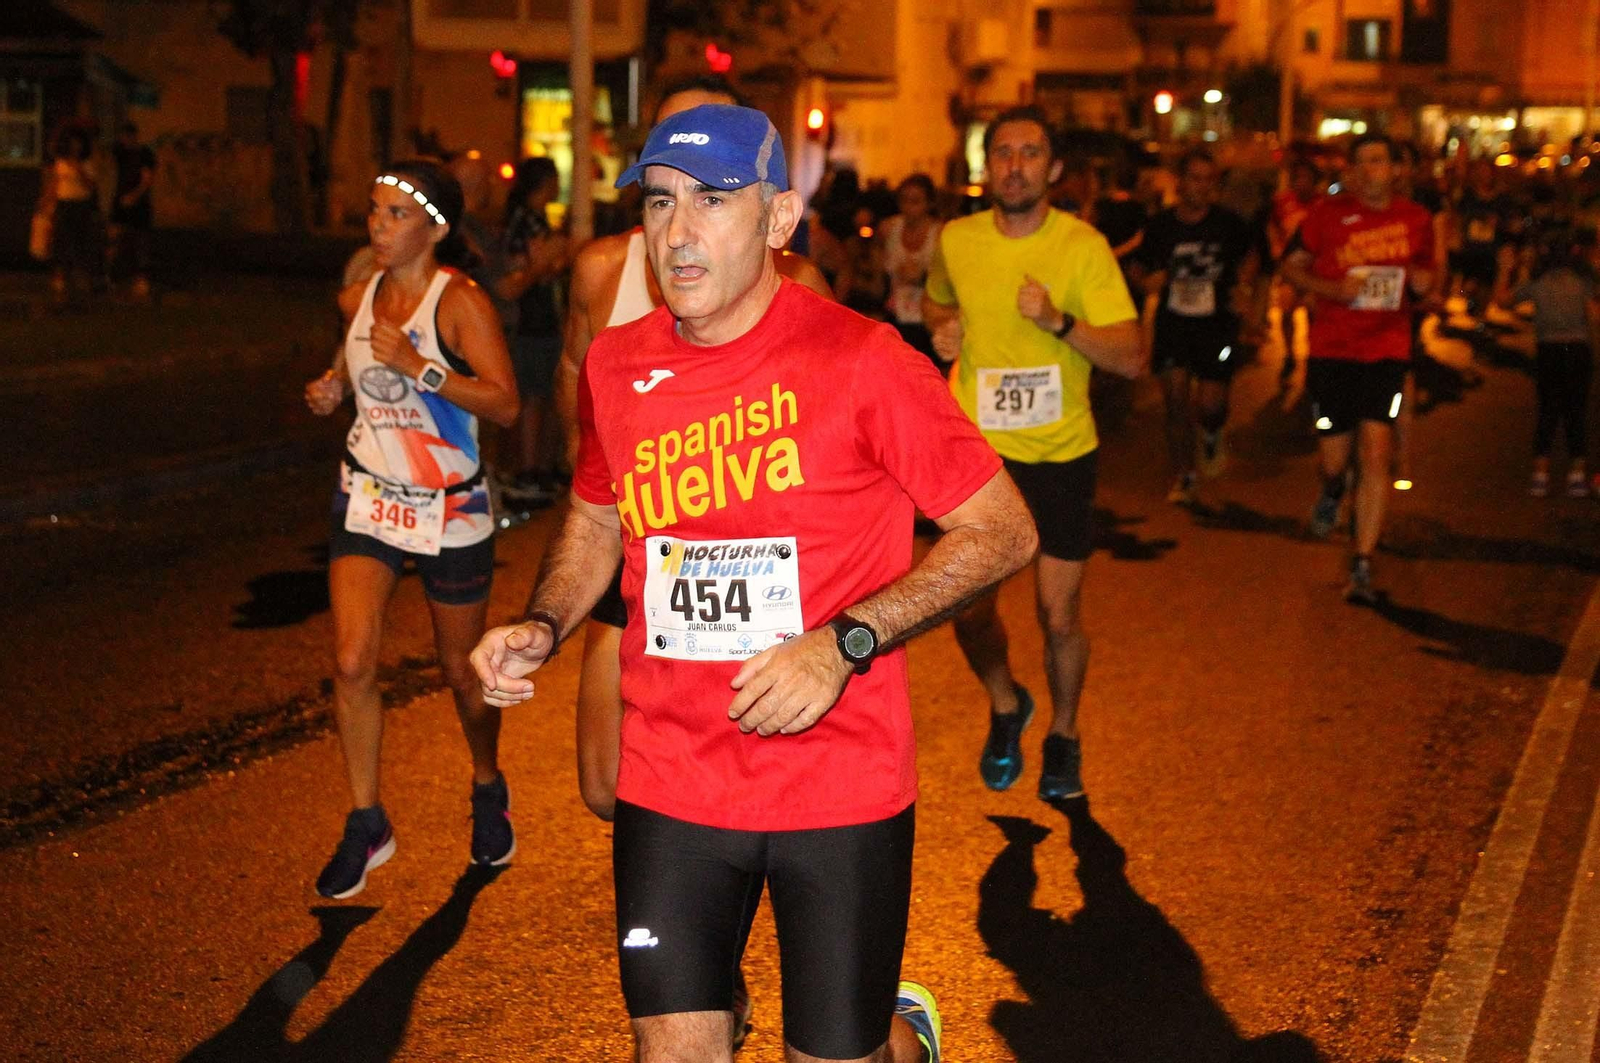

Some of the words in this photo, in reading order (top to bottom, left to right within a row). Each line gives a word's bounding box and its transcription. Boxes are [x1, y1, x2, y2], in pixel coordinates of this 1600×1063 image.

[994, 387, 1035, 411] 297
[367, 406, 421, 419] OYOTA
[634, 383, 798, 476] spanish
[611, 437, 805, 543] Huelva
[370, 499, 416, 530] 346
[683, 543, 778, 561] NOCTURNA
[679, 561, 702, 577] DE
[706, 560, 775, 578] HUELVA
[670, 578, 752, 623] 454
[687, 623, 706, 631] JUAN
[708, 623, 737, 631] CARLOS
